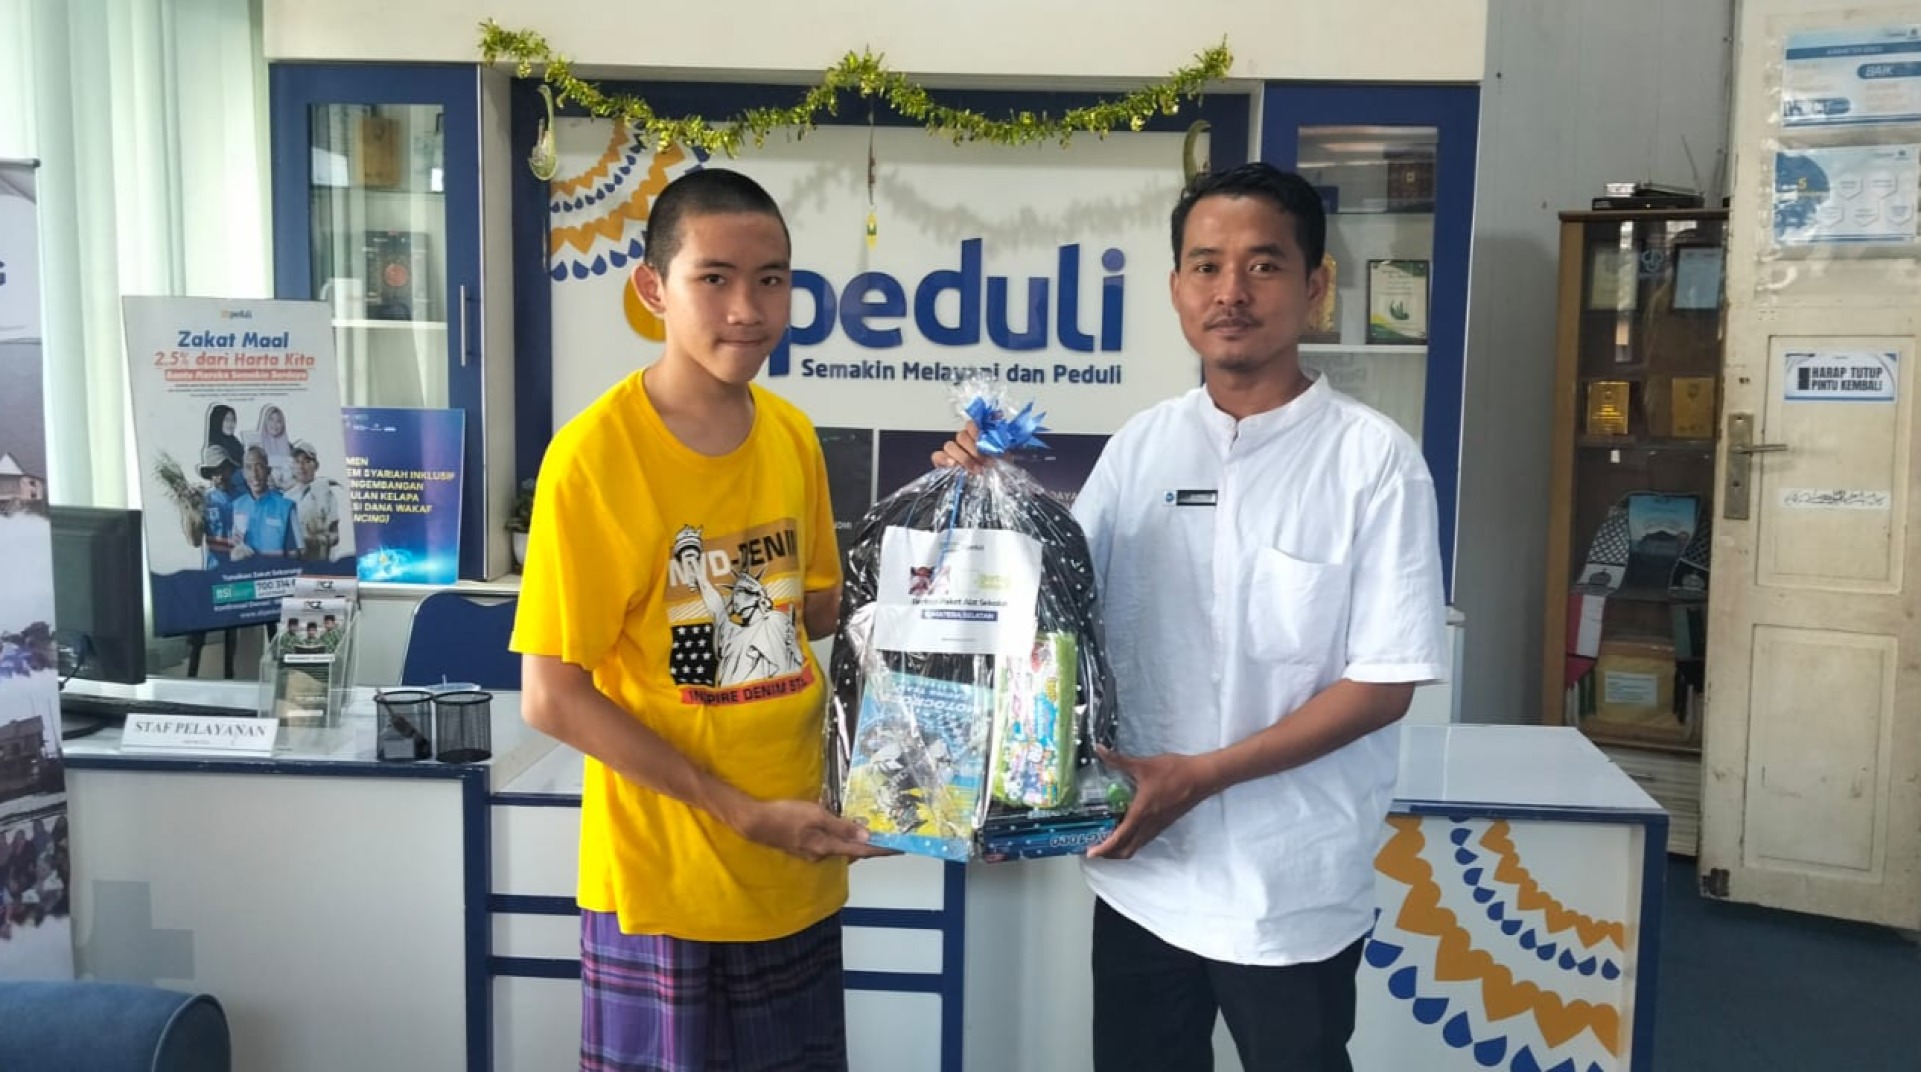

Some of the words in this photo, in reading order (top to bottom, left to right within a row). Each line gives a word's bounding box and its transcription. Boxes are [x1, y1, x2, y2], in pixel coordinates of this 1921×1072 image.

[177, 330, 235, 348] Zakat
[242, 331, 289, 348] Maal
[195, 351, 229, 366] dari
[234, 353, 279, 366] Harta
[284, 352, 315, 366] Kita
[801, 358, 896, 381] Semakin
[902, 361, 1000, 386] Melayani
[1006, 363, 1045, 383] dan
[1053, 364, 1122, 385] Peduli
[1812, 366, 1847, 379] HARAP
[1850, 366, 1883, 379] TUTUP
[1812, 379, 1839, 391] PINTU
[1841, 380, 1883, 391] KEMBALI
[364, 469, 408, 479] SYARIAH
[381, 493, 419, 501] KELAPA
[364, 503, 393, 513] DANA
[396, 504, 432, 513] WAKAF
[742, 680, 786, 700] DENIM
[135, 721, 172, 734] STAF
[175, 722, 267, 738] PELAYANAN
